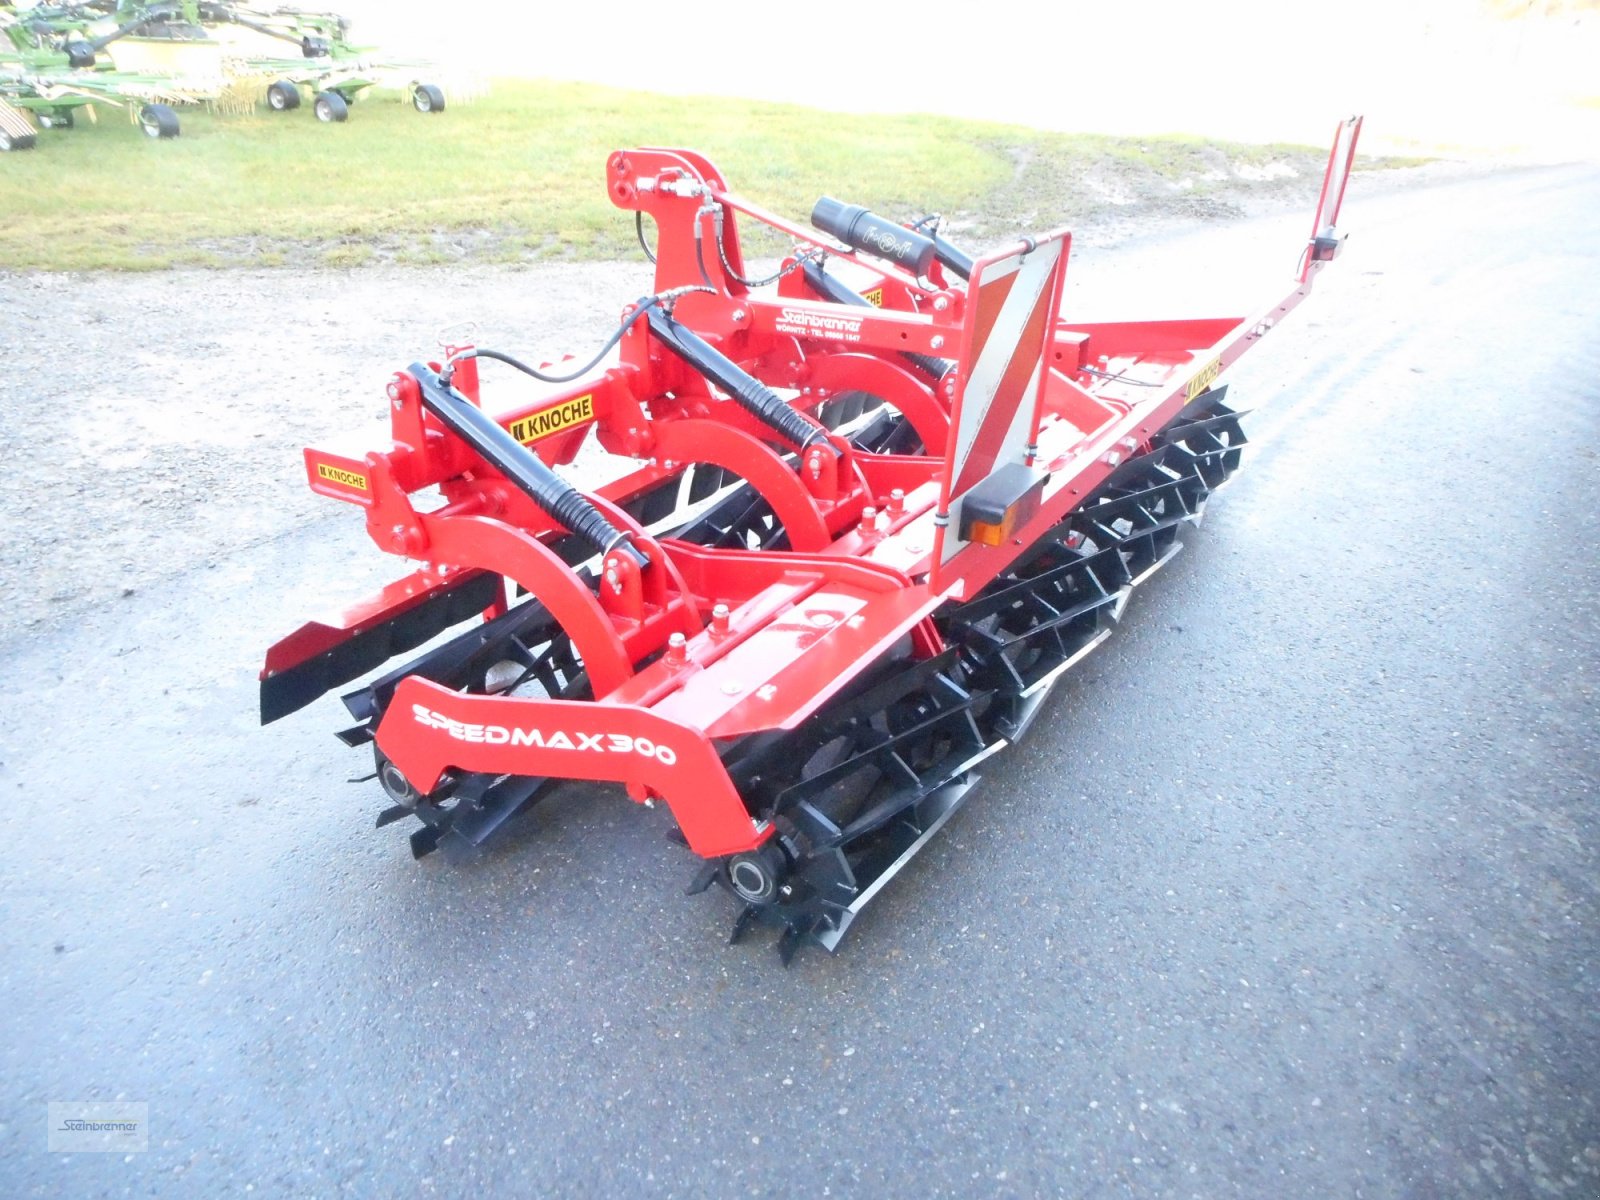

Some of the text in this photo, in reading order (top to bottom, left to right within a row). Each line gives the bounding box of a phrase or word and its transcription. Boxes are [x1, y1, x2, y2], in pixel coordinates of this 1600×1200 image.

[776, 307, 862, 332] Steinbrenner
[528, 398, 591, 437] KNOCHE
[328, 467, 365, 488] KNOCHE
